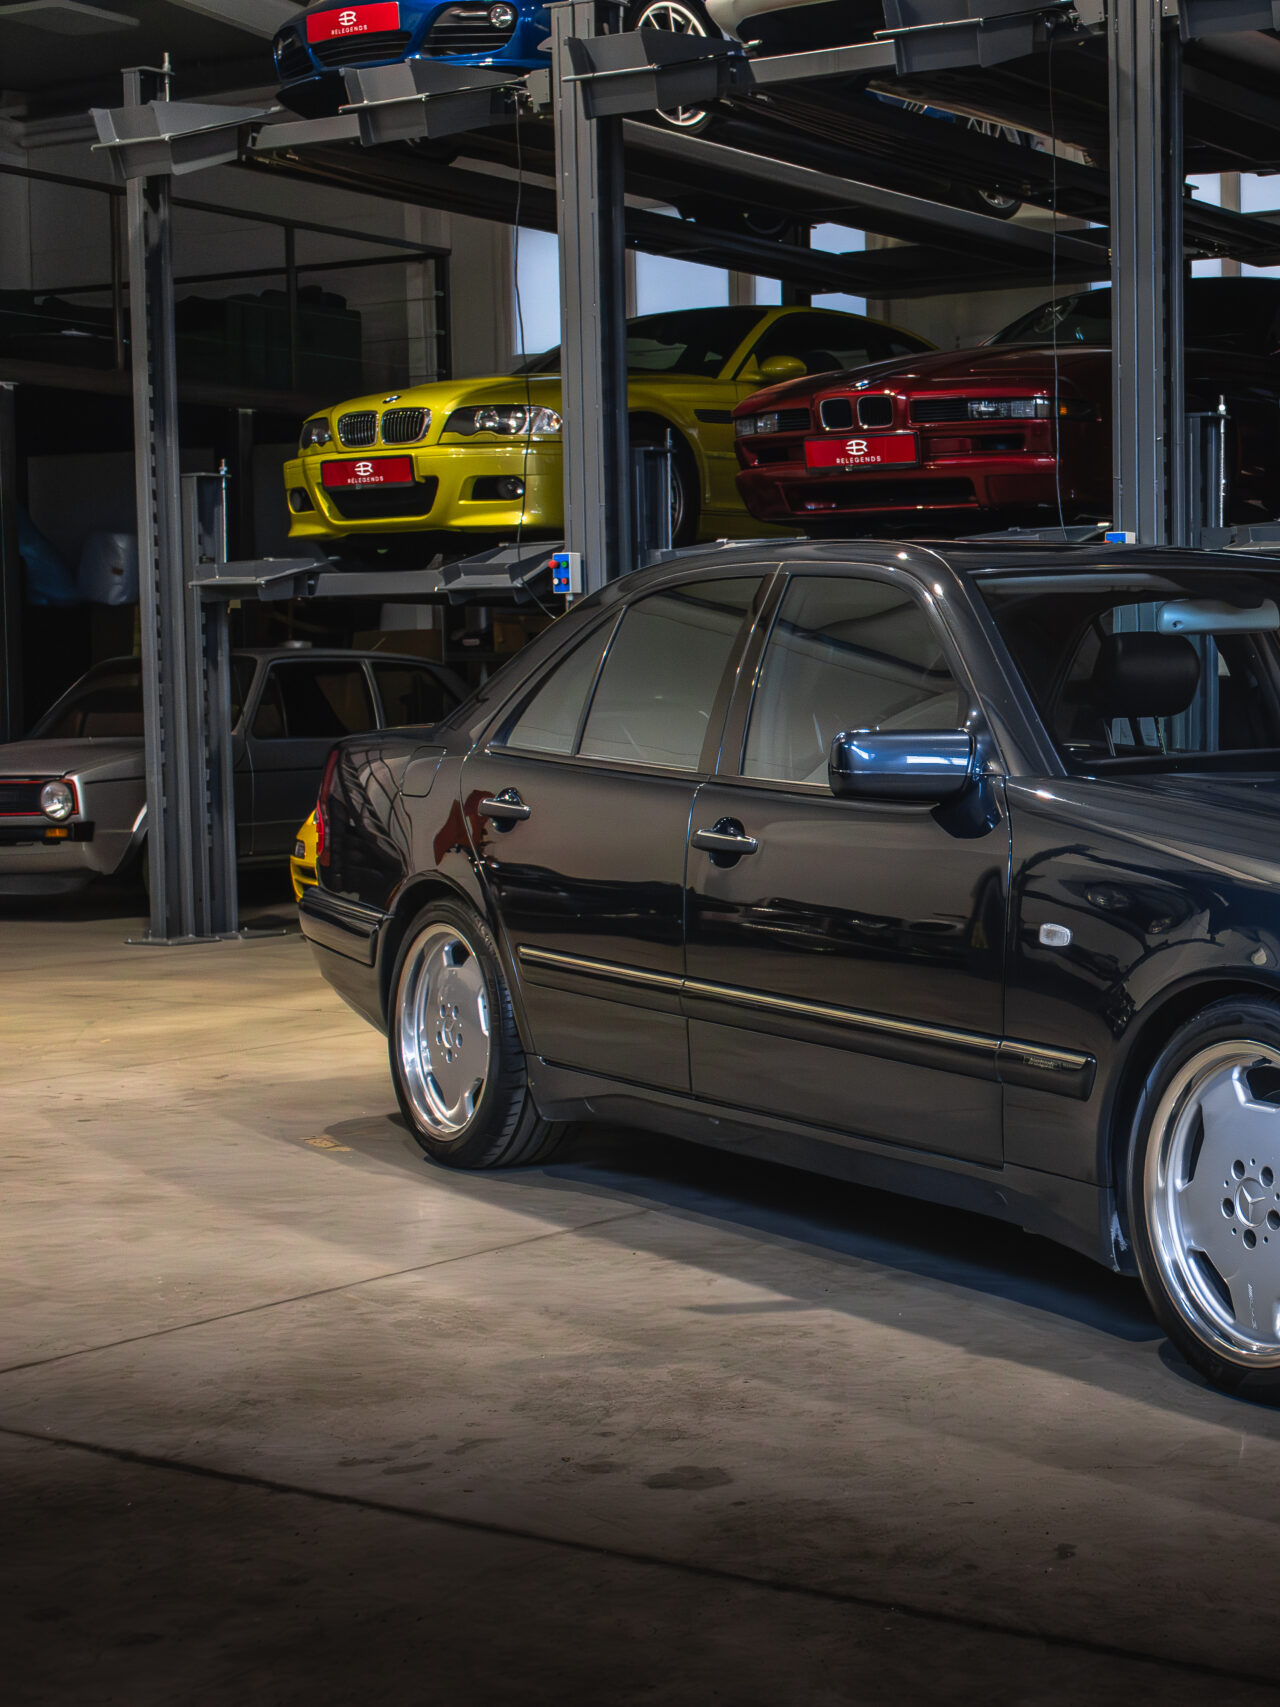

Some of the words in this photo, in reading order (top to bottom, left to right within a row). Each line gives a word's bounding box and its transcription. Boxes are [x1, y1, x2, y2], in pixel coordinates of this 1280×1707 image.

[331, 24, 368, 35] RELEGENDS
[836, 455, 881, 464] RELEGENDS
[347, 475, 384, 484] RELEGENDS
